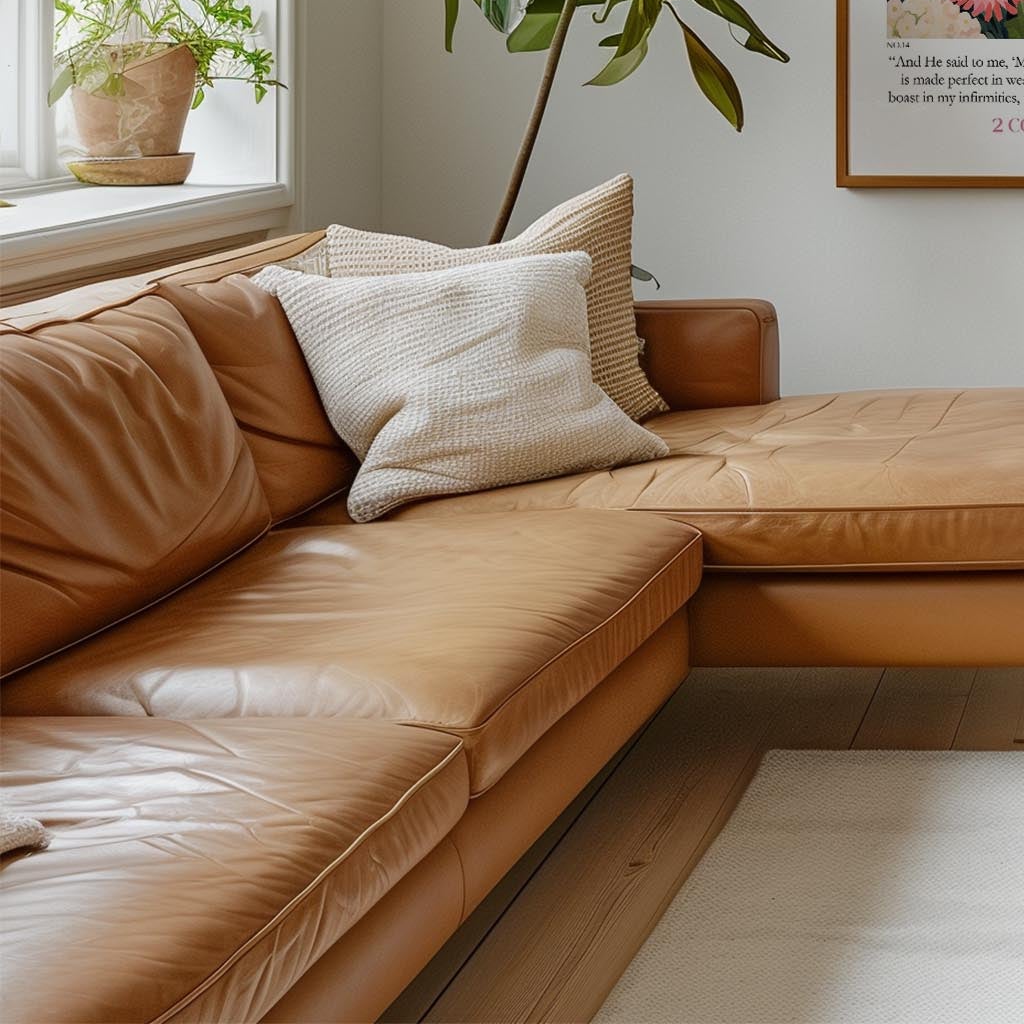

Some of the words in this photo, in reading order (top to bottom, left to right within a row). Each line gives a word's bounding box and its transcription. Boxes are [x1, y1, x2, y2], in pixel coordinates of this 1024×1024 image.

[925, 56, 944, 68] He
[946, 56, 968, 67] said
[972, 58, 983, 67] to
[986, 59, 1008, 69] me,
[901, 73, 909, 85] is
[913, 73, 945, 85] made
[947, 73, 988, 89] perfect
[991, 74, 1003, 85] in
[888, 91, 920, 103] boast
[923, 91, 933, 103] in
[938, 95, 956, 106] my
[959, 91, 1020, 105] infirmities,
[992, 118, 1003, 132] 2
